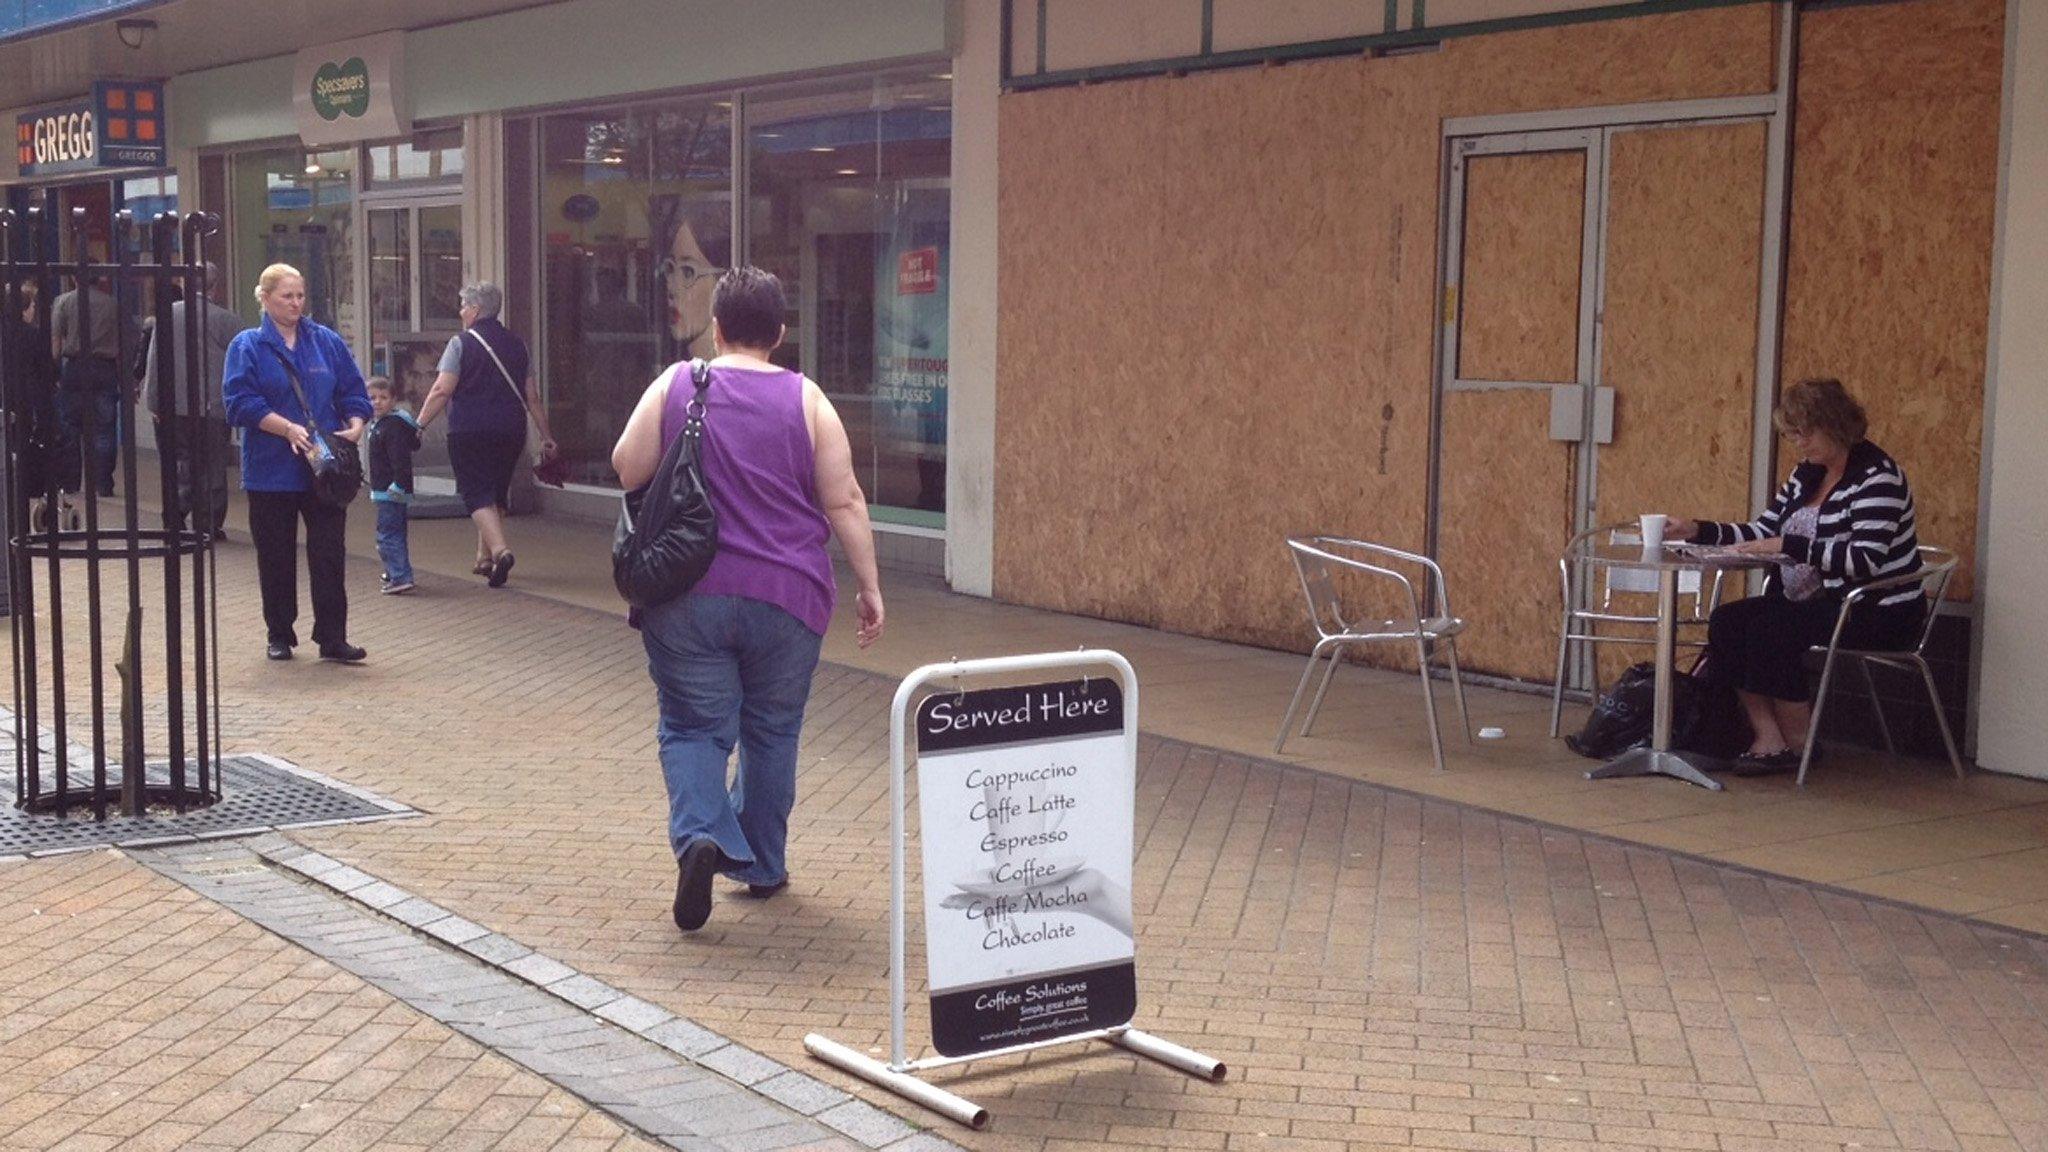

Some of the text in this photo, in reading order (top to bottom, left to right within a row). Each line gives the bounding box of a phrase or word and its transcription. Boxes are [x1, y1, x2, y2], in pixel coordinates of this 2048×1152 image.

[316, 75, 366, 98] Specsavers
[118, 150, 157, 162] GREGGS
[928, 690, 1111, 734] Served Here
[966, 762, 1078, 791] Cappuccino
[969, 793, 1077, 827] Caffe Latte
[980, 830, 1069, 855] Espresso
[995, 858, 1058, 886] Coffee
[966, 886, 1088, 923] Caffe Mocha
[982, 922, 1077, 950] Chocolate
[975, 981, 1088, 1011] Coffee Solutions
